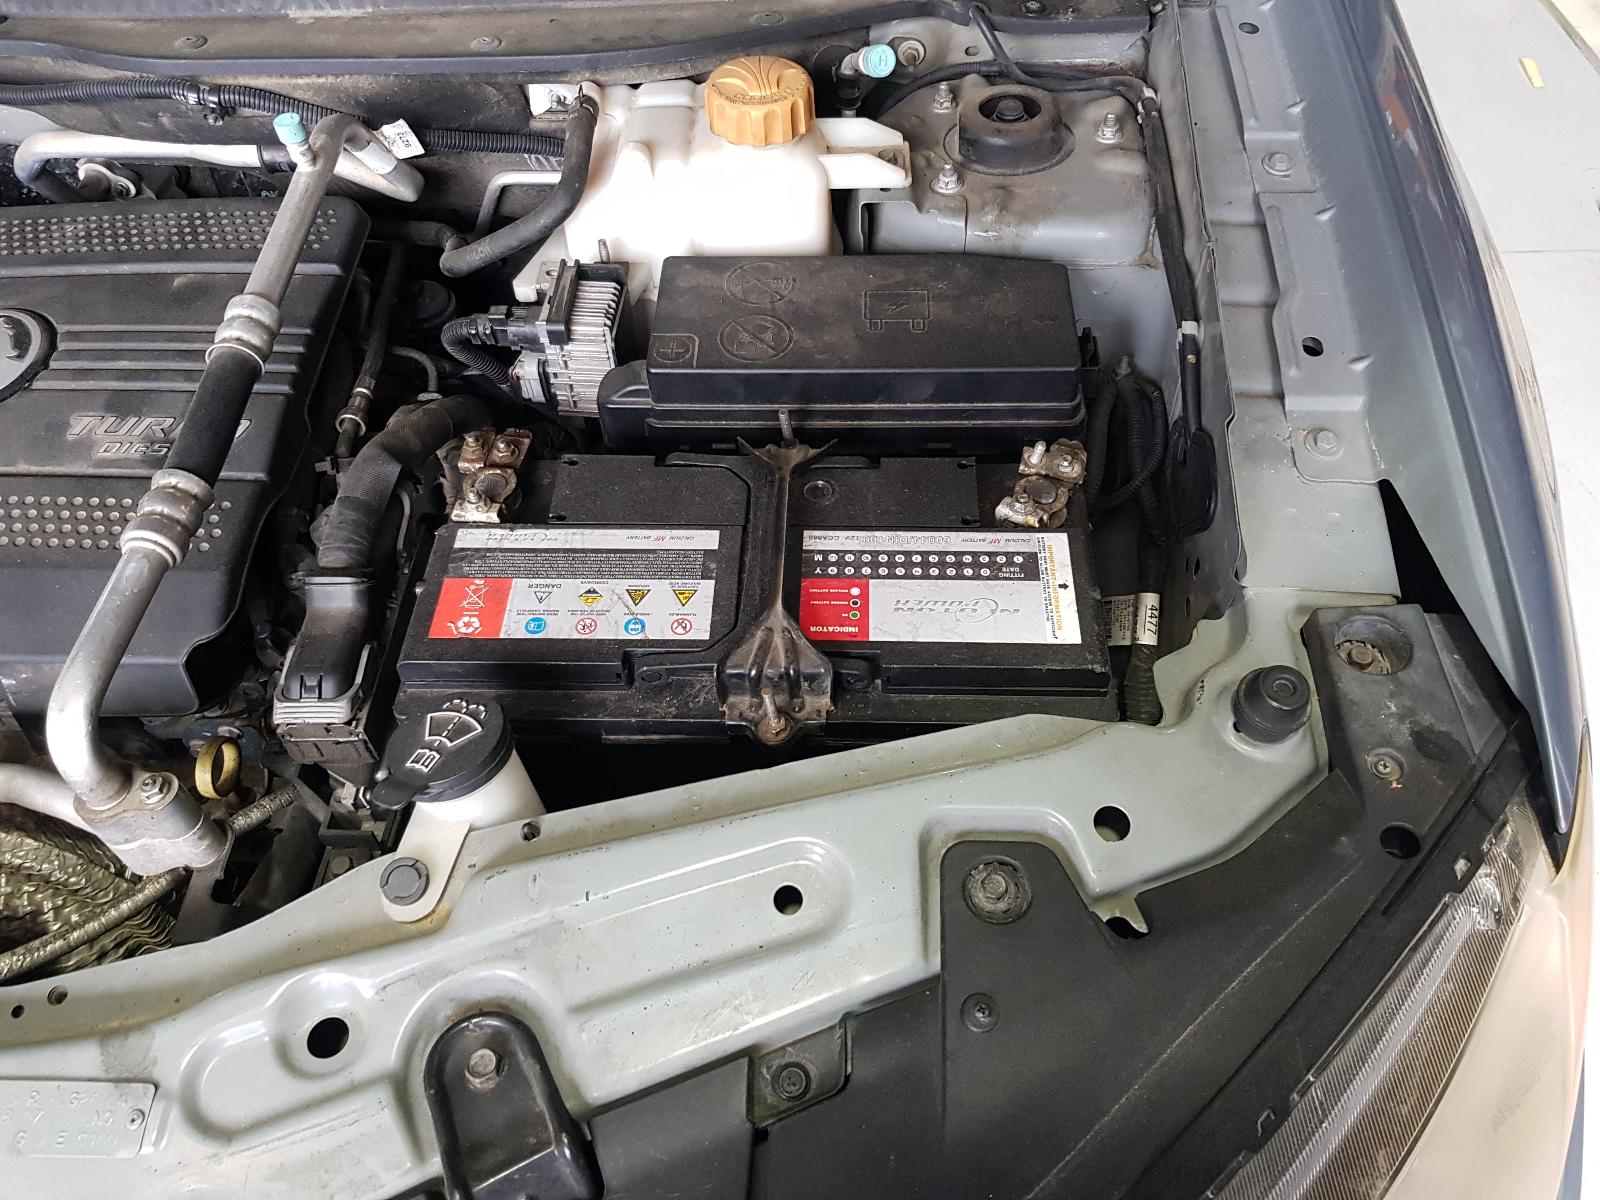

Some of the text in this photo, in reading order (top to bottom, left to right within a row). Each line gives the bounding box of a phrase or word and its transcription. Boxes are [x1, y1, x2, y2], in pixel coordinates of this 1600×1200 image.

[68, 415, 252, 439] TUR
[97, 441, 172, 456] DIES
[1047, 544, 1063, 631] IMPORTANT INFORMATION
[893, 599, 979, 607] POWER
[1147, 604, 1158, 636] 4477
